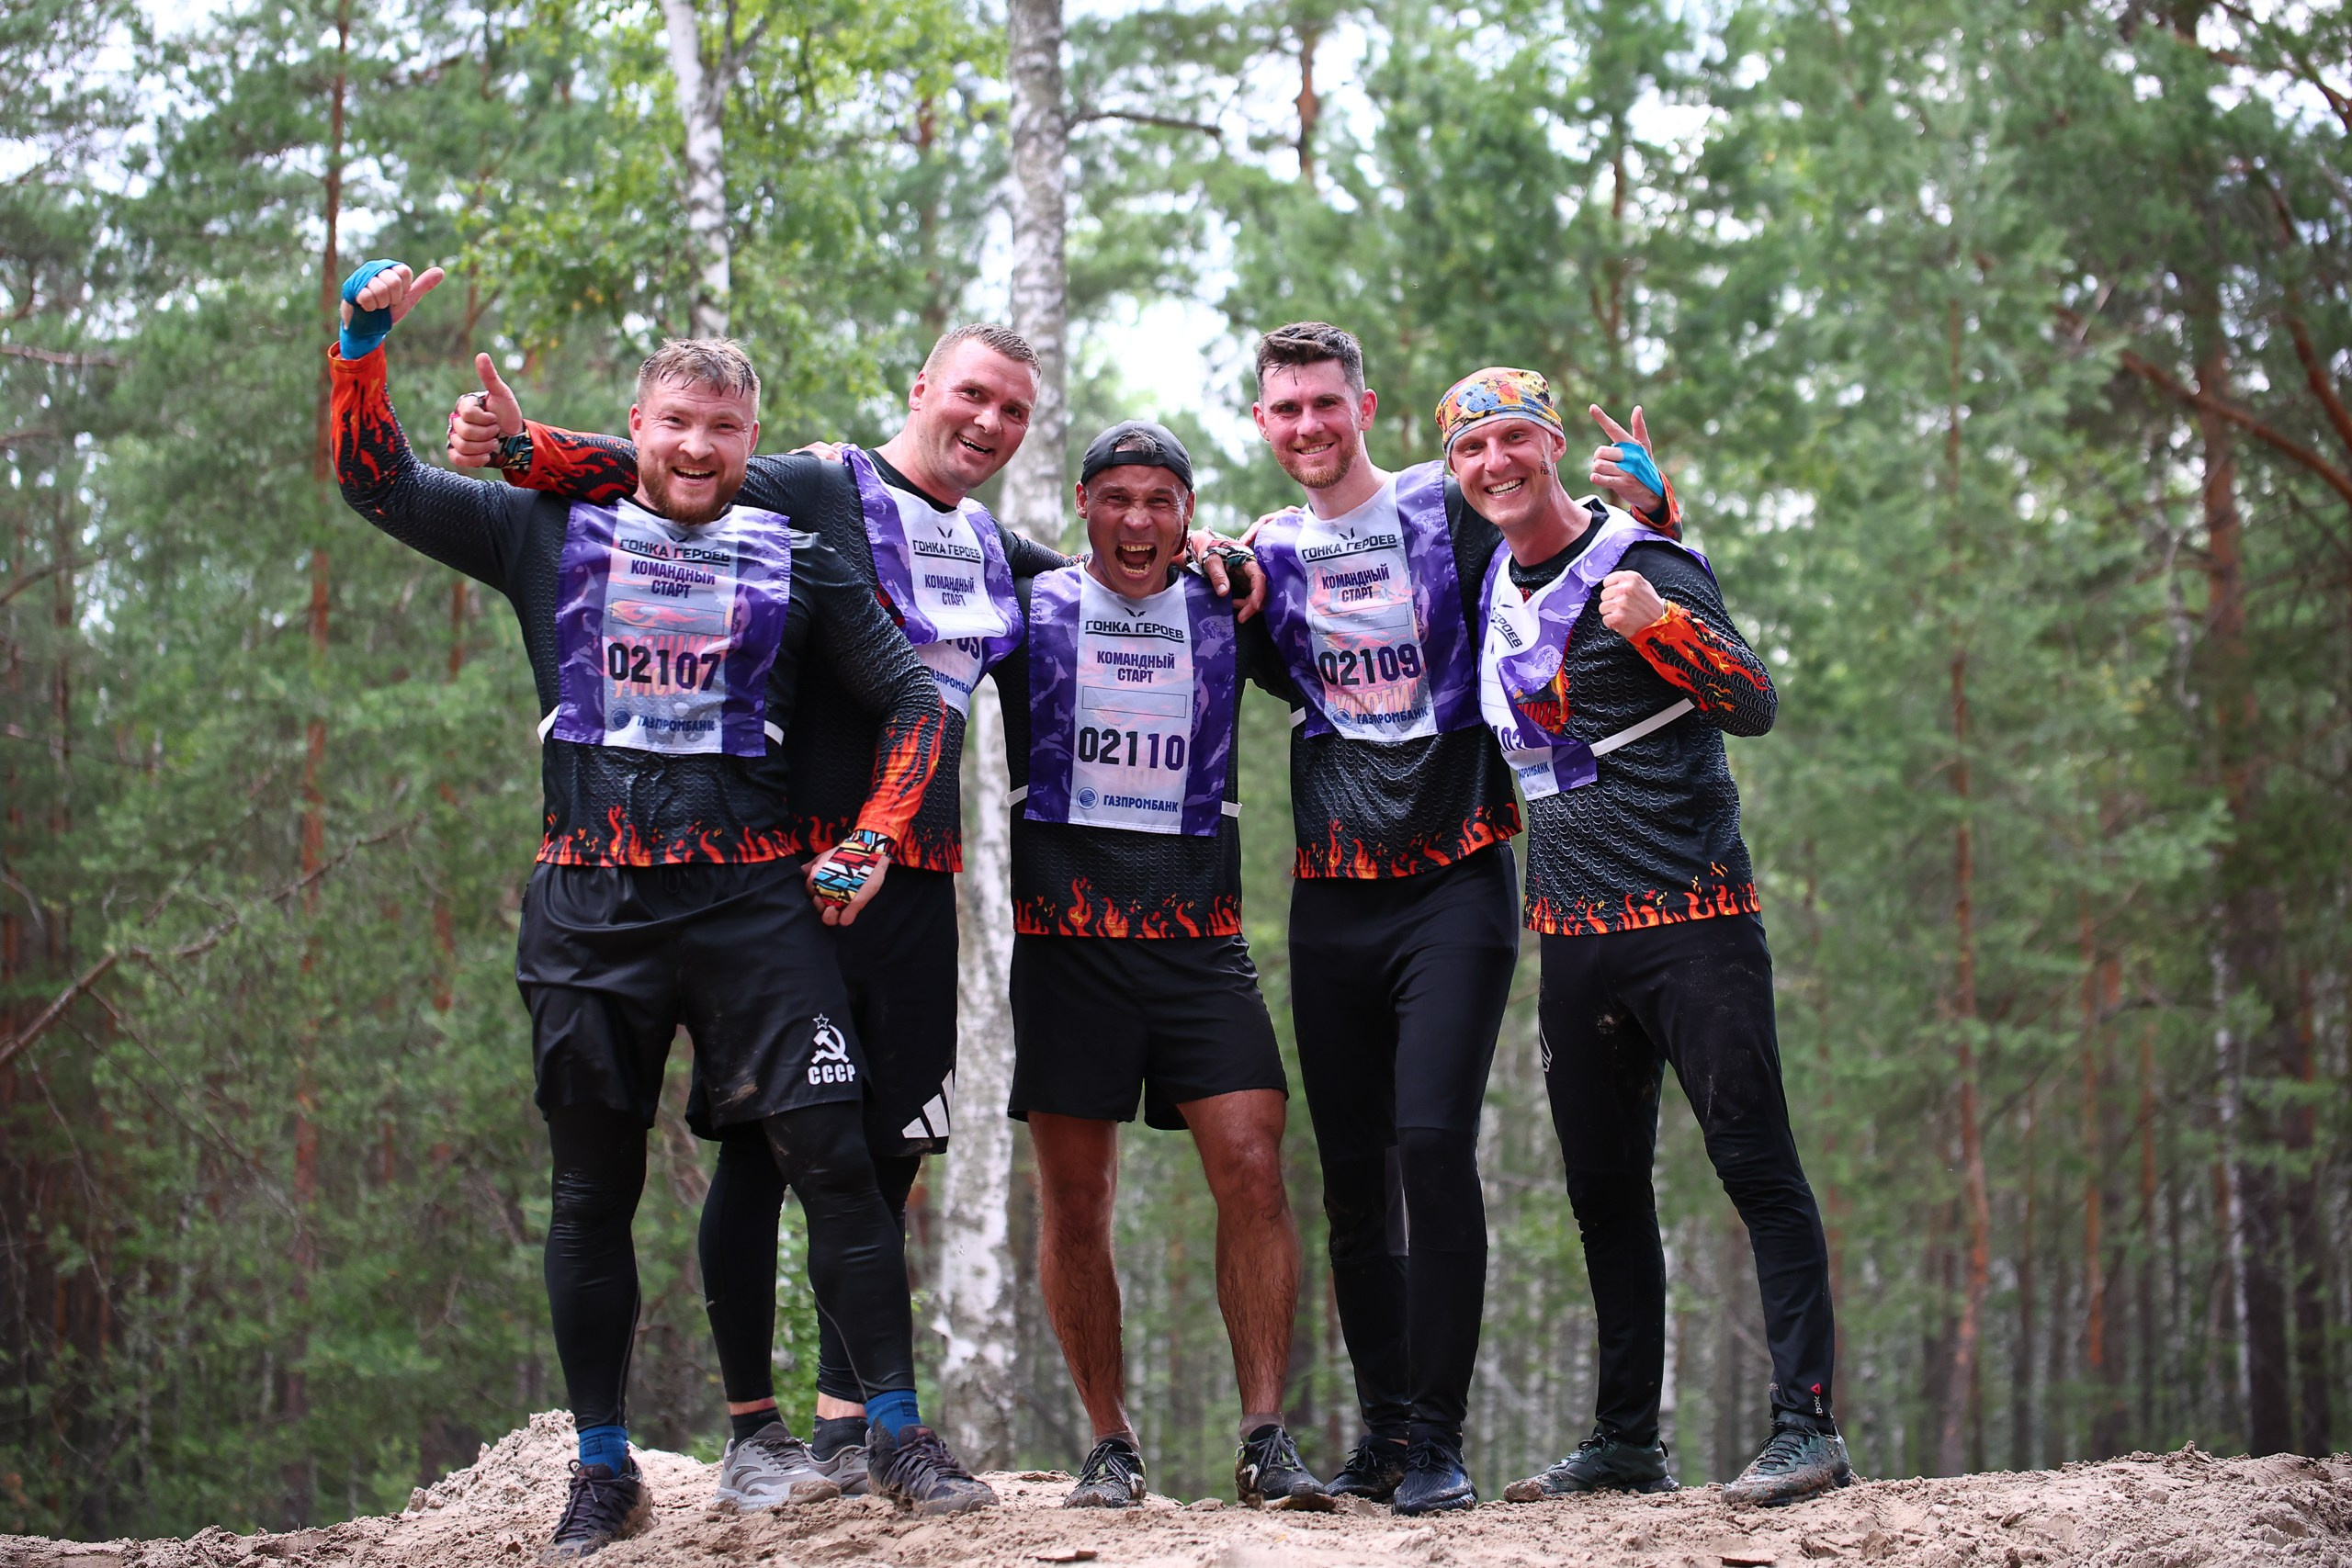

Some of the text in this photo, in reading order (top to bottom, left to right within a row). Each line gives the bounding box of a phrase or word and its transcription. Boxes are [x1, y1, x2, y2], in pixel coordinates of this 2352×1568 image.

[619, 538, 731, 562] ГОНКА ГЕРОЕВ
[912, 540, 981, 558] ГОНКА ГЕРОЕВ
[1301, 534, 1397, 560] ГОНКА ГЕРОЕВ
[630, 560, 716, 585] КОМАНДНЫЙ
[1322, 563, 1390, 590] КОМАНДНЫЙ
[651, 580, 692, 598] СТАРТ
[924, 574, 976, 594] КОМАНДНЫЙ
[942, 592, 967, 606] СТАРТ
[1341, 586, 1374, 603] СТАРТ
[1085, 620, 1184, 639] ГОНКА ГЕРОЕВ
[607, 642, 721, 691] 02107
[1097, 650, 1175, 670] КОМАНДНЫЙ
[1317, 643, 1422, 686] 02109
[1117, 668, 1154, 683] СТАРТ
[637, 714, 716, 731] ГАЗПРОМБАНК
[1356, 706, 1430, 724] ГАЗПРОМБАНК
[1078, 727, 1185, 771] 02110
[1103, 795, 1179, 813] ГАЗПРОМБАНК
[808, 1064, 856, 1085] СССР
